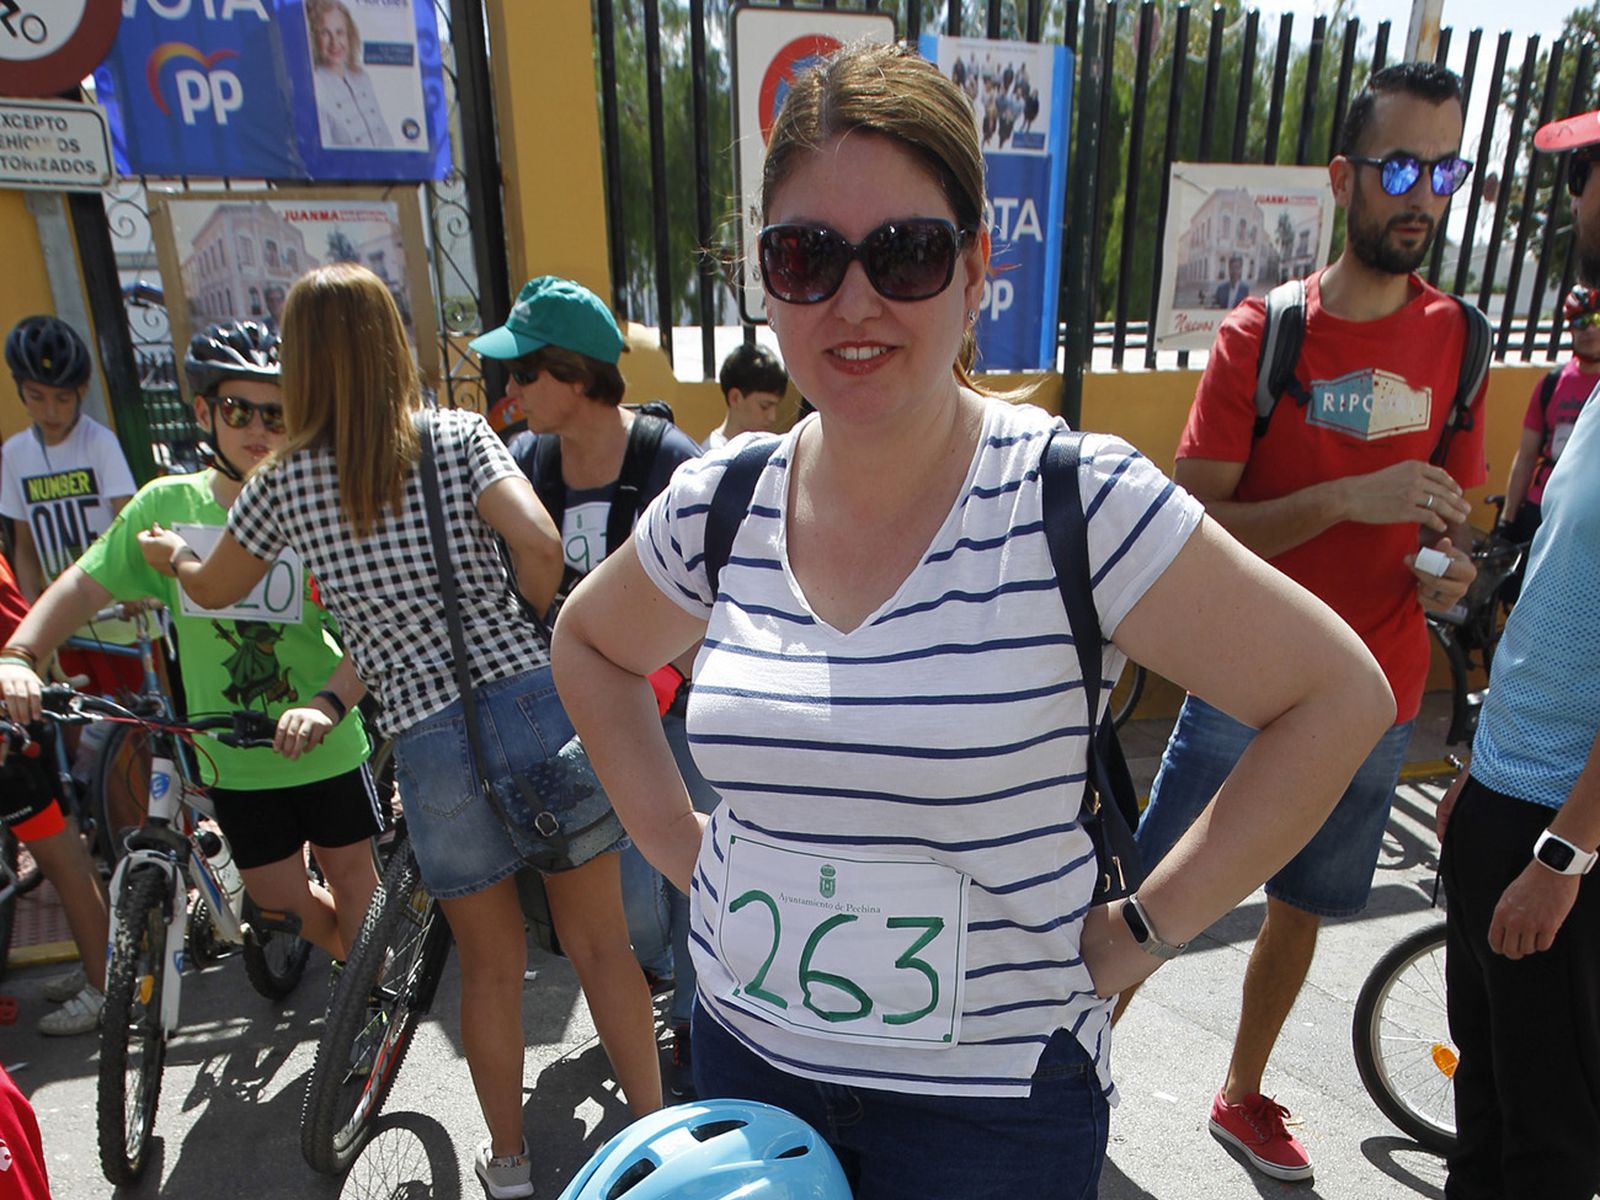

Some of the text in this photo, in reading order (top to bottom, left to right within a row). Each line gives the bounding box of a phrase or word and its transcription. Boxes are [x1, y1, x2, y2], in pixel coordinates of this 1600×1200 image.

[0, 113, 68, 132] XCEPTO
[284, 209, 338, 224] JUANMA
[28, 471, 92, 502] NUMBER
[779, 892, 881, 914] Ayuntamiento de Pechina
[729, 889, 944, 1025] 263
